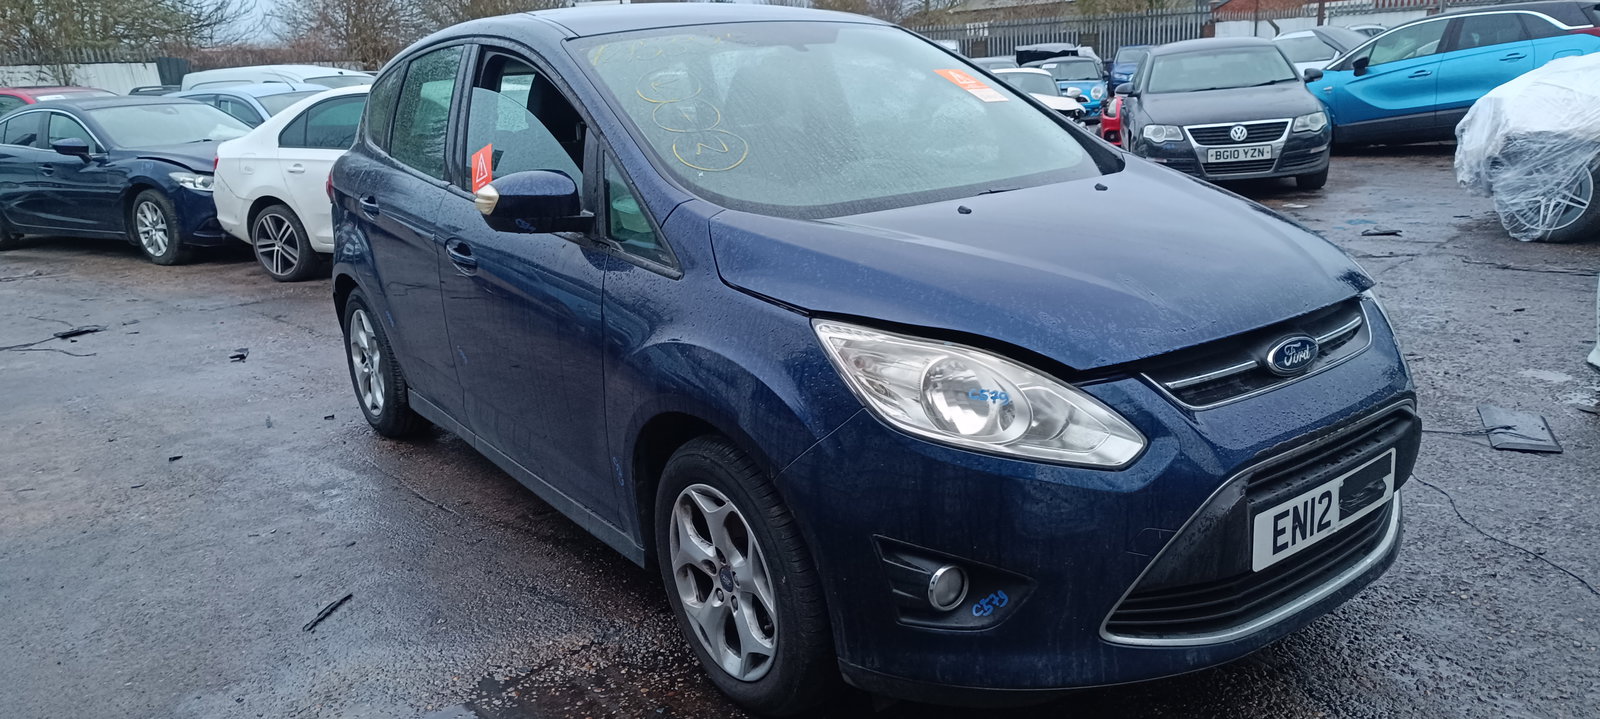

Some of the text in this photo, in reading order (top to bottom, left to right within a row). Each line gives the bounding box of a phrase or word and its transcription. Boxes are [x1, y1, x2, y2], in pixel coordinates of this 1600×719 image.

[1214, 147, 1265, 161] BG10 YZN
[1283, 341, 1311, 367] Ford
[1272, 489, 1334, 556] EN12
